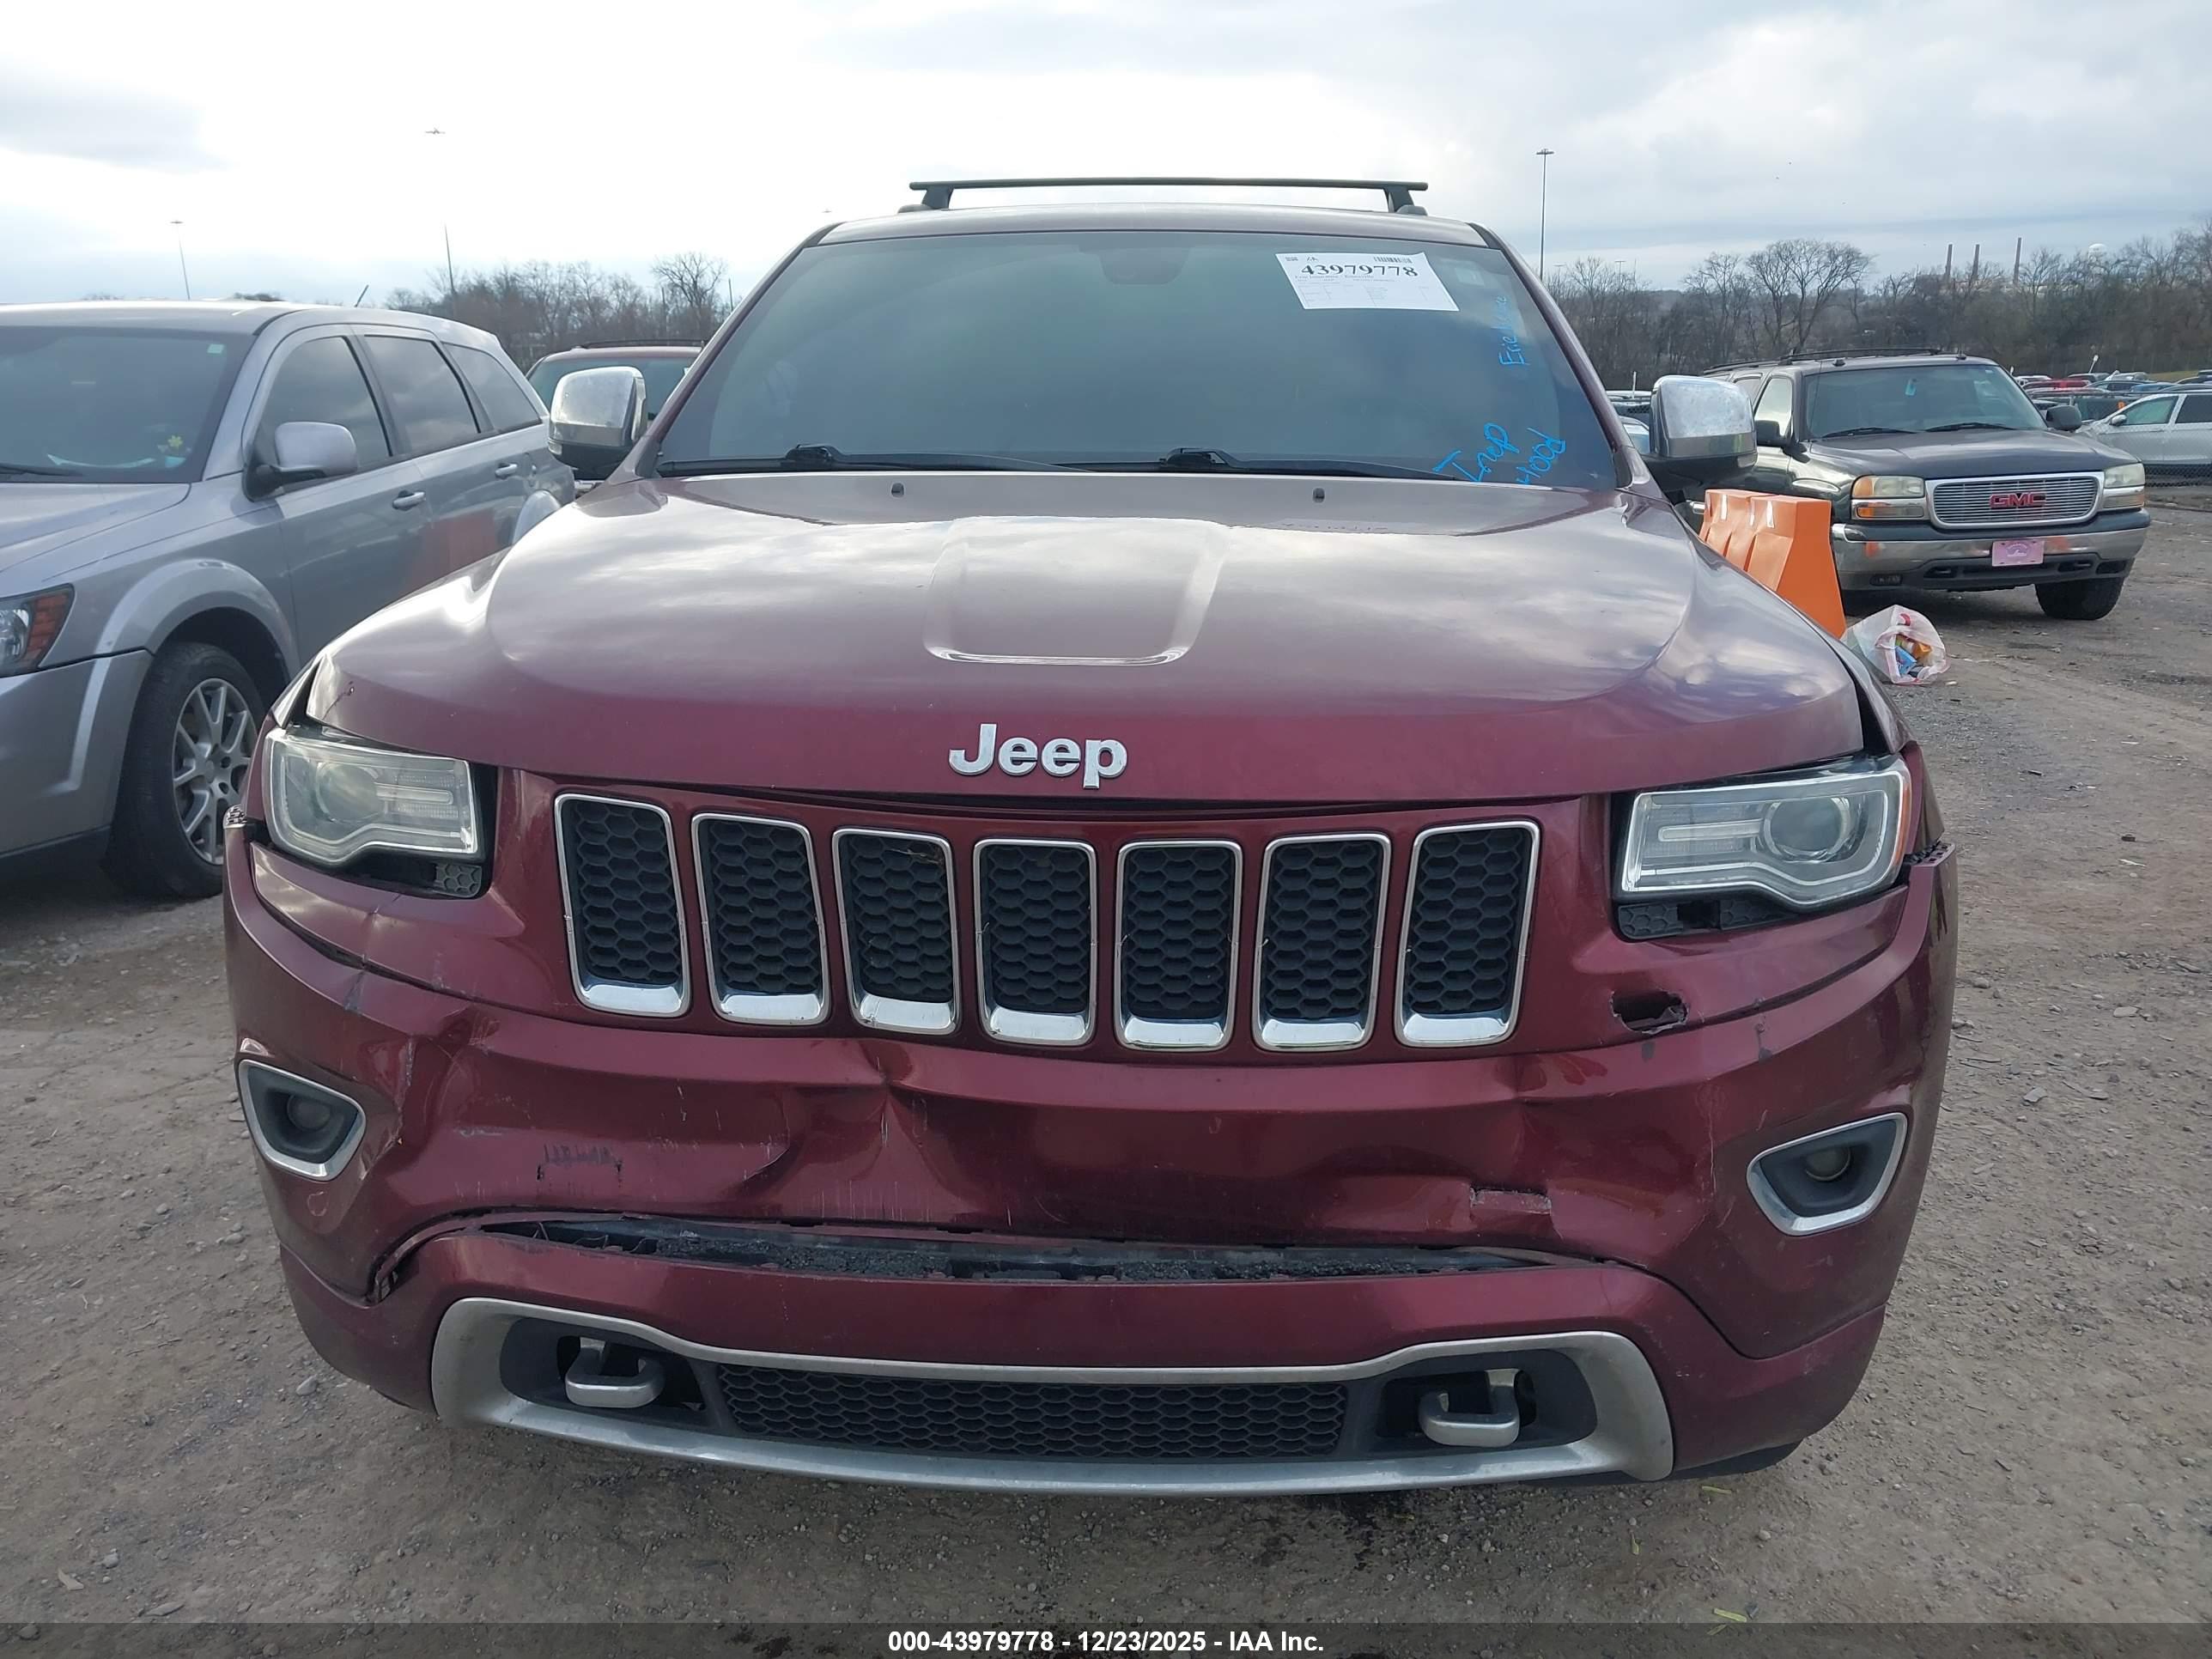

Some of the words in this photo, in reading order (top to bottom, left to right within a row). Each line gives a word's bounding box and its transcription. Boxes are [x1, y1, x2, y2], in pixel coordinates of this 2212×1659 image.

[1301, 264, 1419, 277] 43979778
[1990, 491, 2046, 508] GMC
[949, 723, 1127, 789] Jeep
